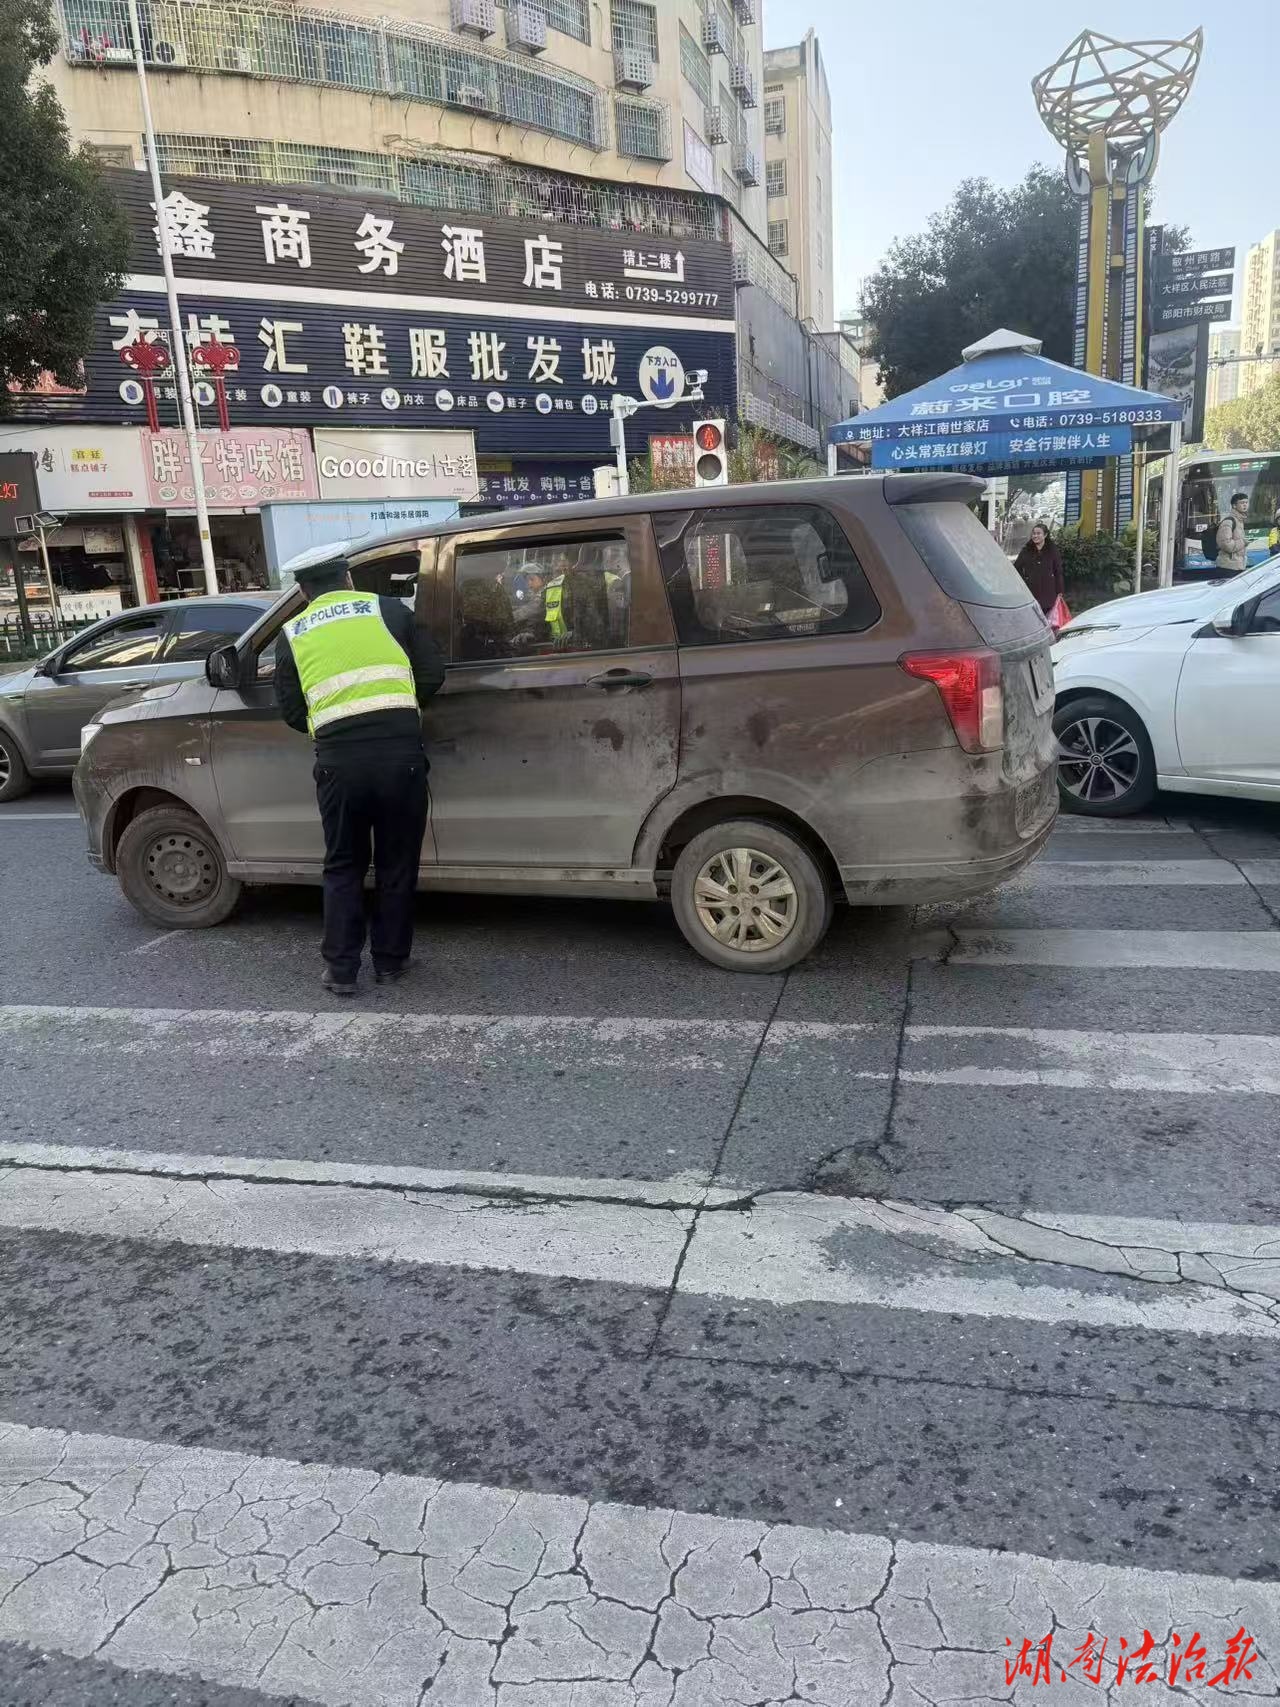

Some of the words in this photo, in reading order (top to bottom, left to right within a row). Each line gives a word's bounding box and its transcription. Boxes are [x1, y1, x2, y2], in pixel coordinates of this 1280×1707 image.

[149, 191, 562, 290] 鑫商务酒店
[623, 250, 671, 269] 请上二楼
[646, 355, 678, 367] 下方入口
[287, 390, 311, 403] 童装
[347, 392, 370, 405] 裤子
[403, 394, 425, 406] 内衣
[457, 395, 479, 407] 床品
[507, 397, 528, 409] 鞋子
[555, 398, 574, 410] 箱包
[910, 389, 1092, 416] 蔚来口腔
[891, 440, 988, 460] 心头常亮红绿灯
[1009, 433, 1111, 453] 安全行驶伴人生
[439, 454, 474, 477] 古茗
[310, 603, 350, 624] POLICE
